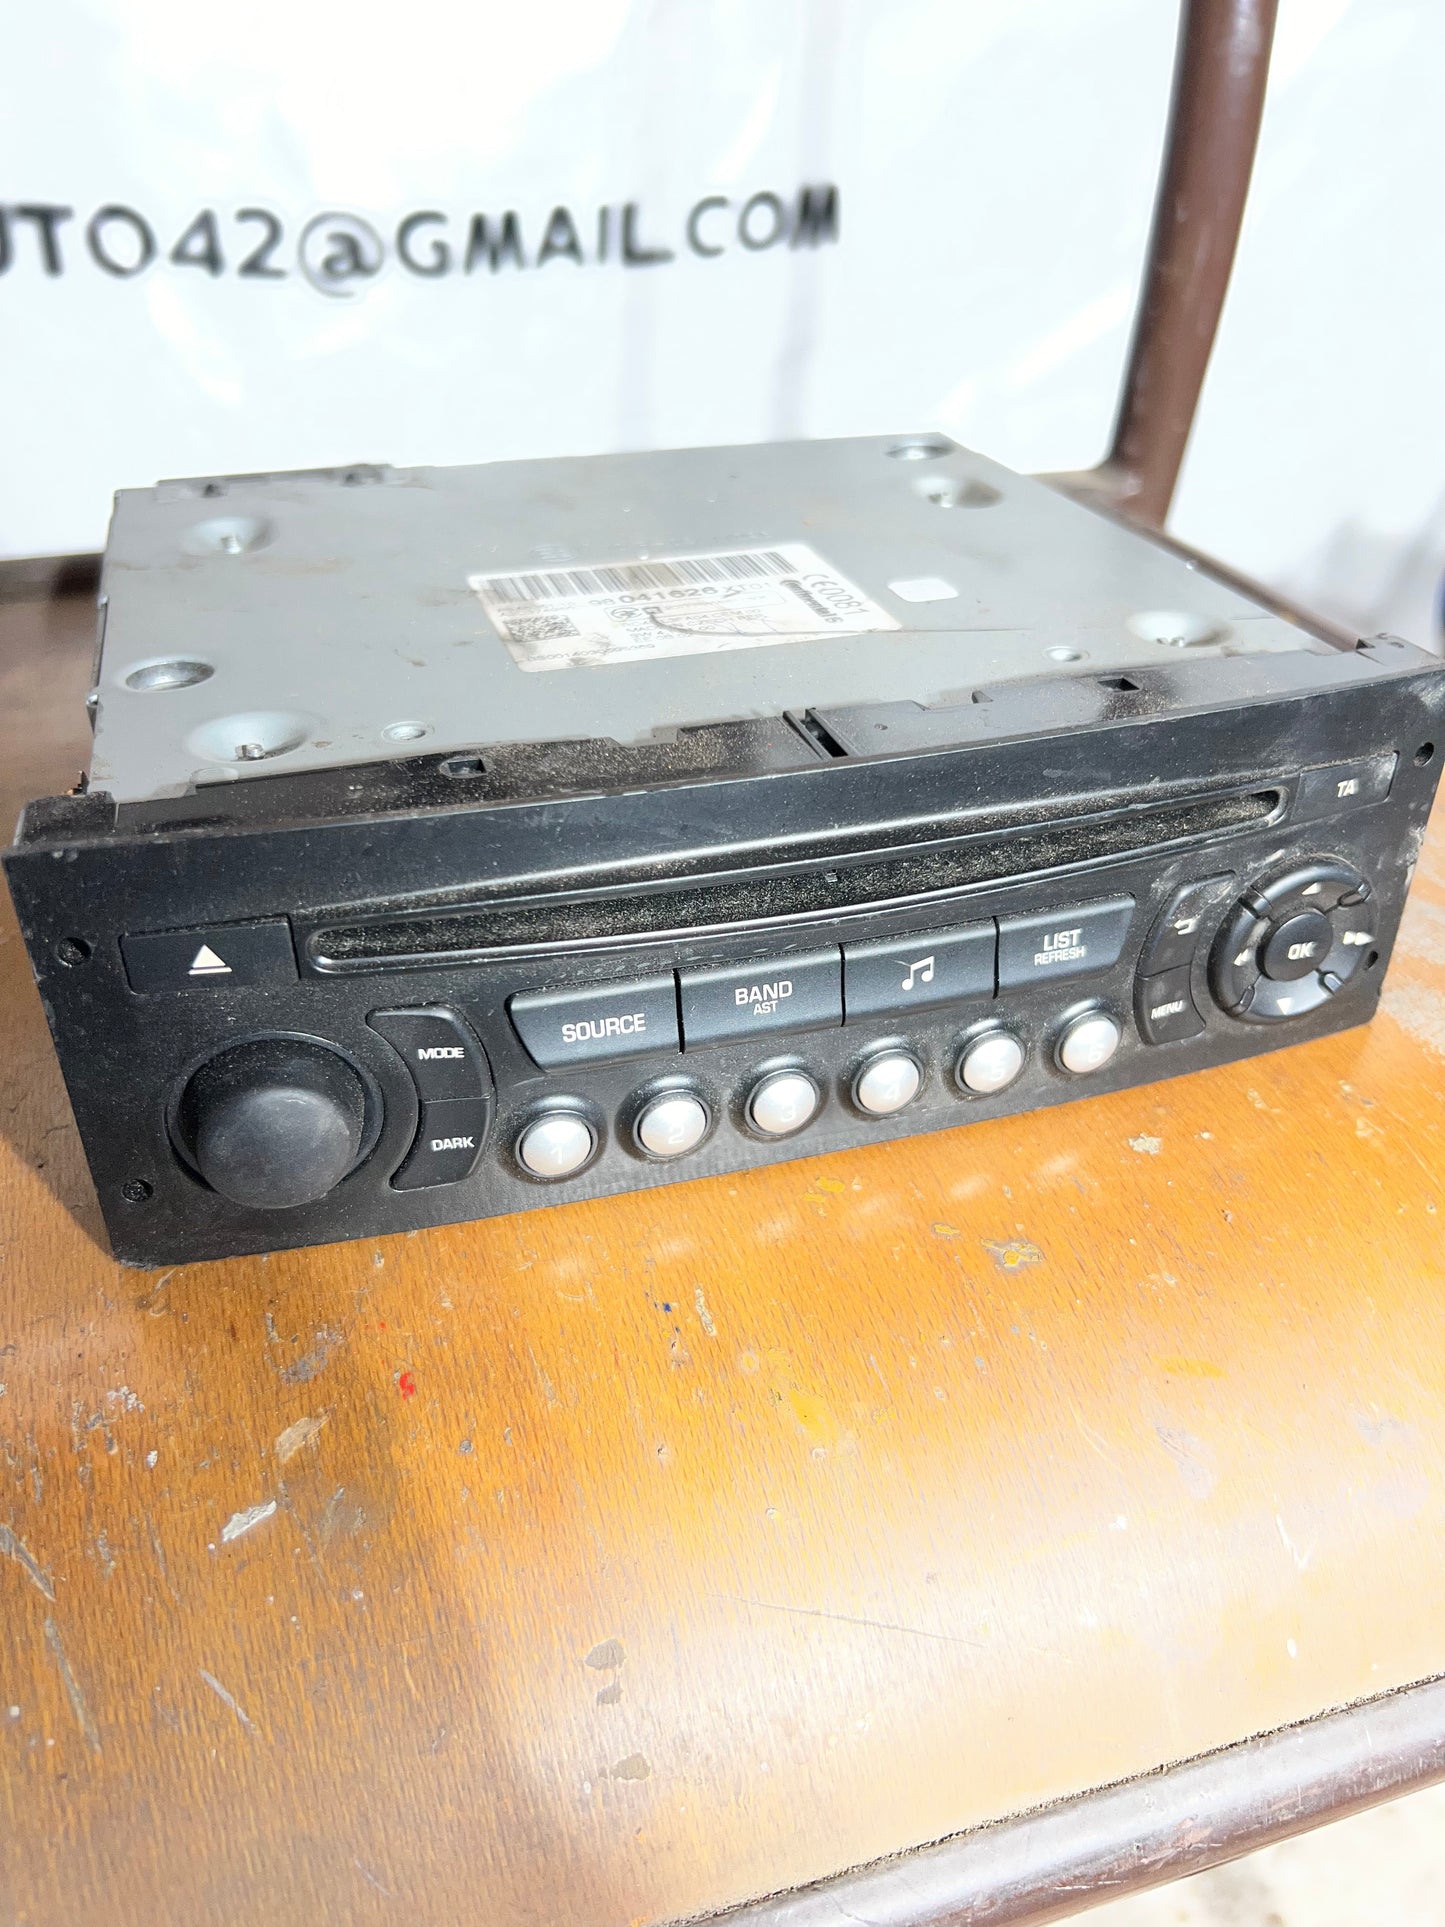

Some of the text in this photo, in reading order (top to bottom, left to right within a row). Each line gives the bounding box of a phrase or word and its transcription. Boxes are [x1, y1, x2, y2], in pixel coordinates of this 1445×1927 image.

[1337, 780, 1359, 798] TA
[1043, 928, 1083, 951] LIST
[1034, 944, 1086, 966] REFRESH
[1287, 941, 1317, 960] OK
[735, 980, 792, 1005] BAND
[753, 1000, 778, 1016] AST
[1150, 1000, 1184, 1020] MENU
[562, 1013, 646, 1043] SOURCE
[418, 1046, 465, 1060] MODE
[431, 1136, 475, 1152] DARK
[668, 1127, 685, 1145] 2
[550, 1146, 565, 1164] 1
